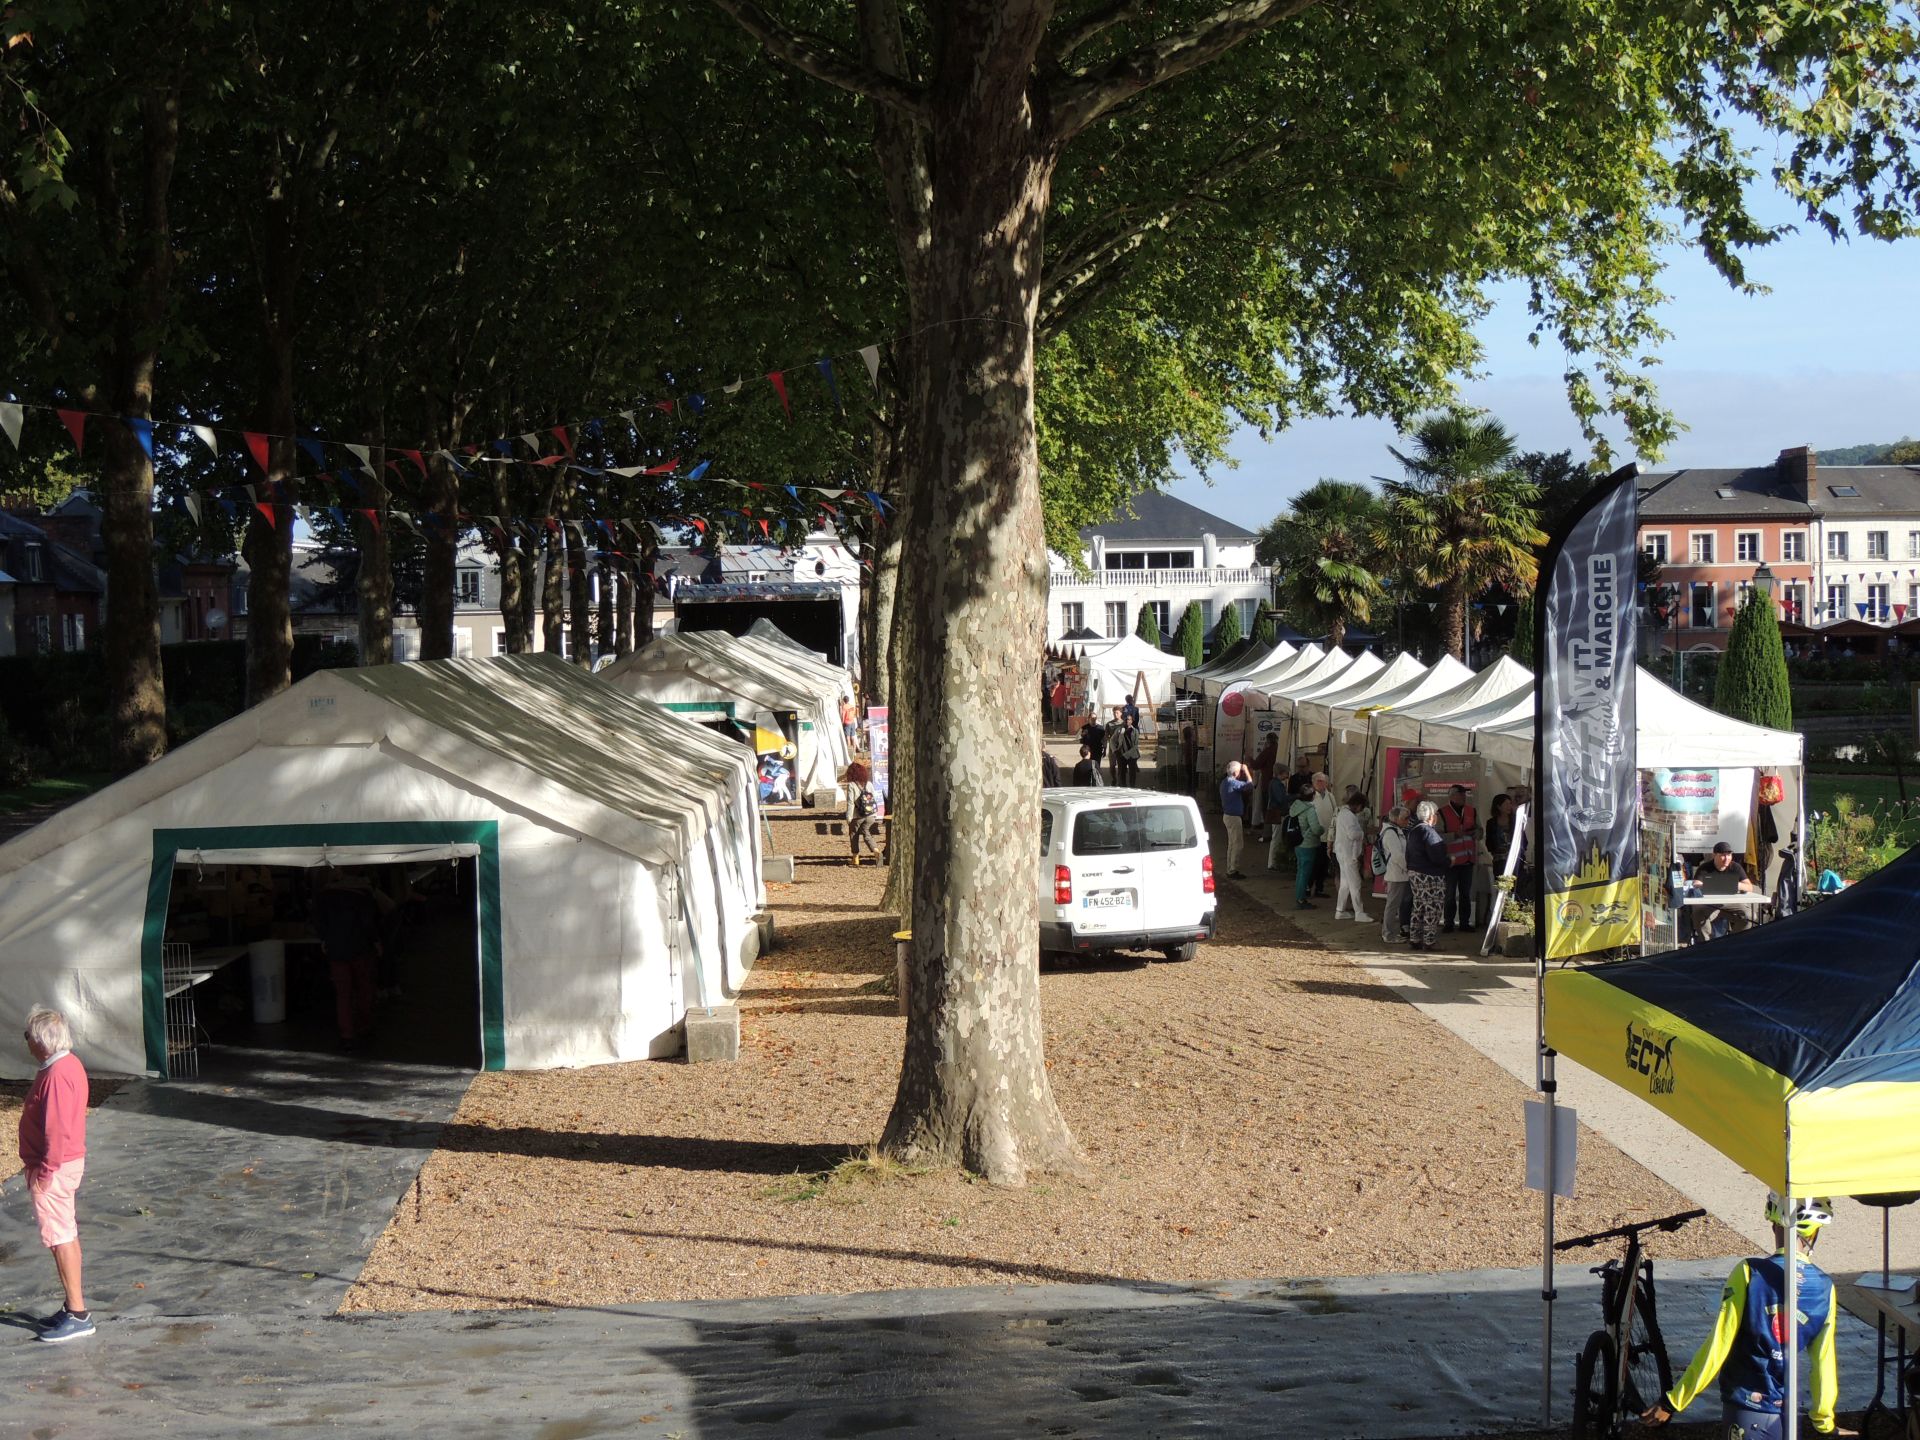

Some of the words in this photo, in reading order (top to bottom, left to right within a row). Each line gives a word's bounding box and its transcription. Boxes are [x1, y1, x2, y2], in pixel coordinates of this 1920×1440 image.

[1593, 559, 1612, 668] MARCHE
[1573, 644, 1592, 692] VTT
[1595, 675, 1611, 691] &
[1580, 720, 1613, 812] ECT
[1629, 1034, 1666, 1076] ECT
